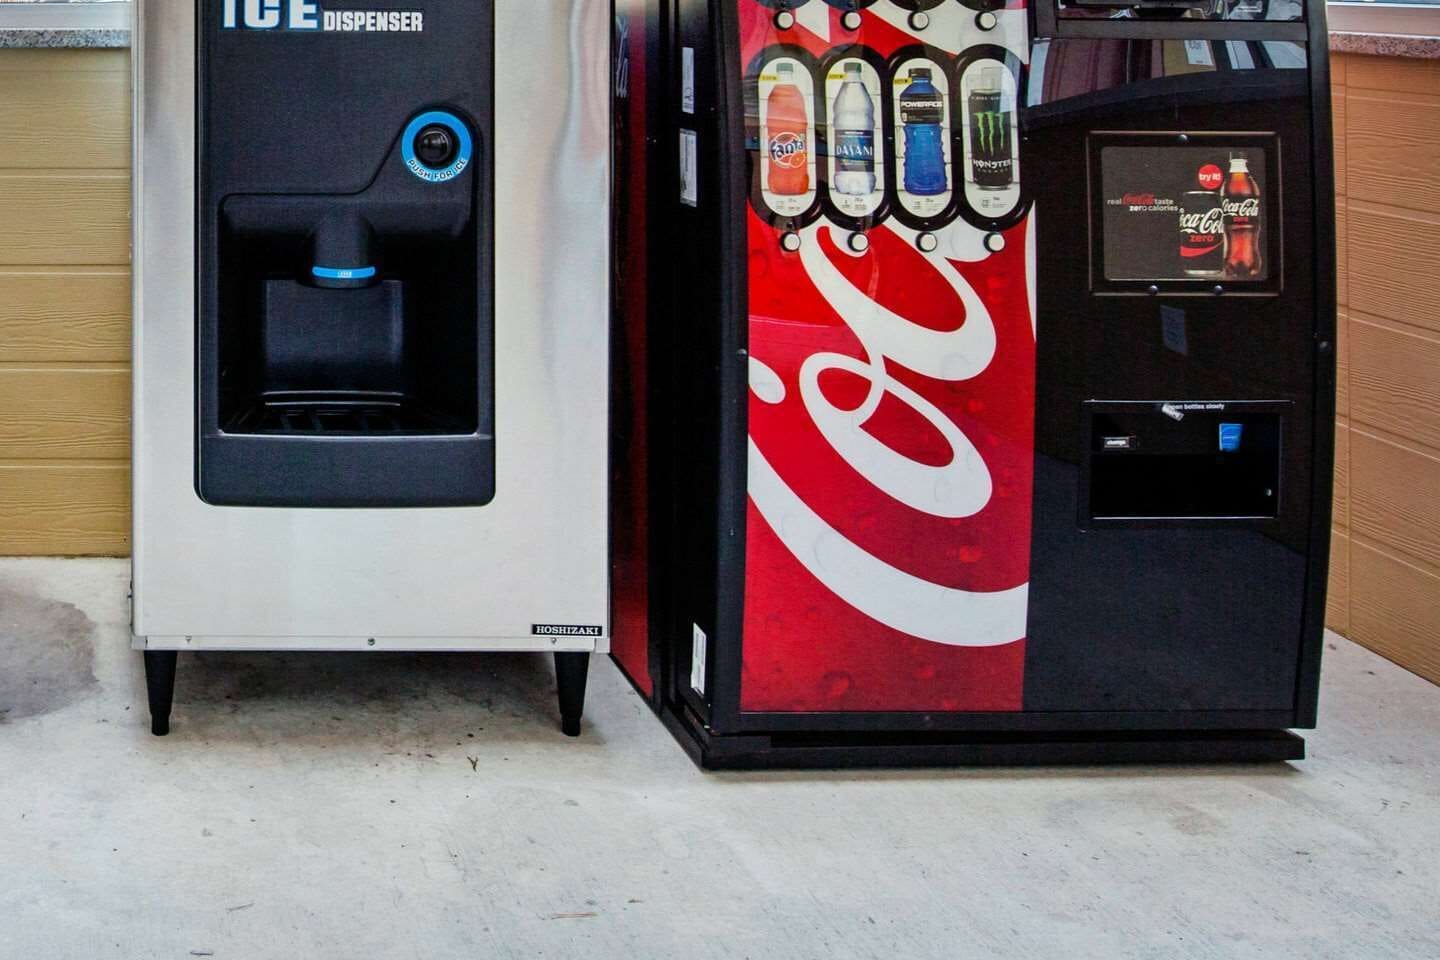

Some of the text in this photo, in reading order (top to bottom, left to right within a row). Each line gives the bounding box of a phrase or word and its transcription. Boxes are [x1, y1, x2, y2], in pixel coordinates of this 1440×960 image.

[323, 10, 424, 32] DISPENSER
[408, 158, 467, 180] PUSH FOR ICE
[1199, 172, 1222, 182] try it!
[1129, 203, 1179, 212] zero calories
[1222, 198, 1259, 217] Coca-Cola
[1189, 234, 1215, 243] zero
[535, 625, 599, 635] HOSHIZAKI
